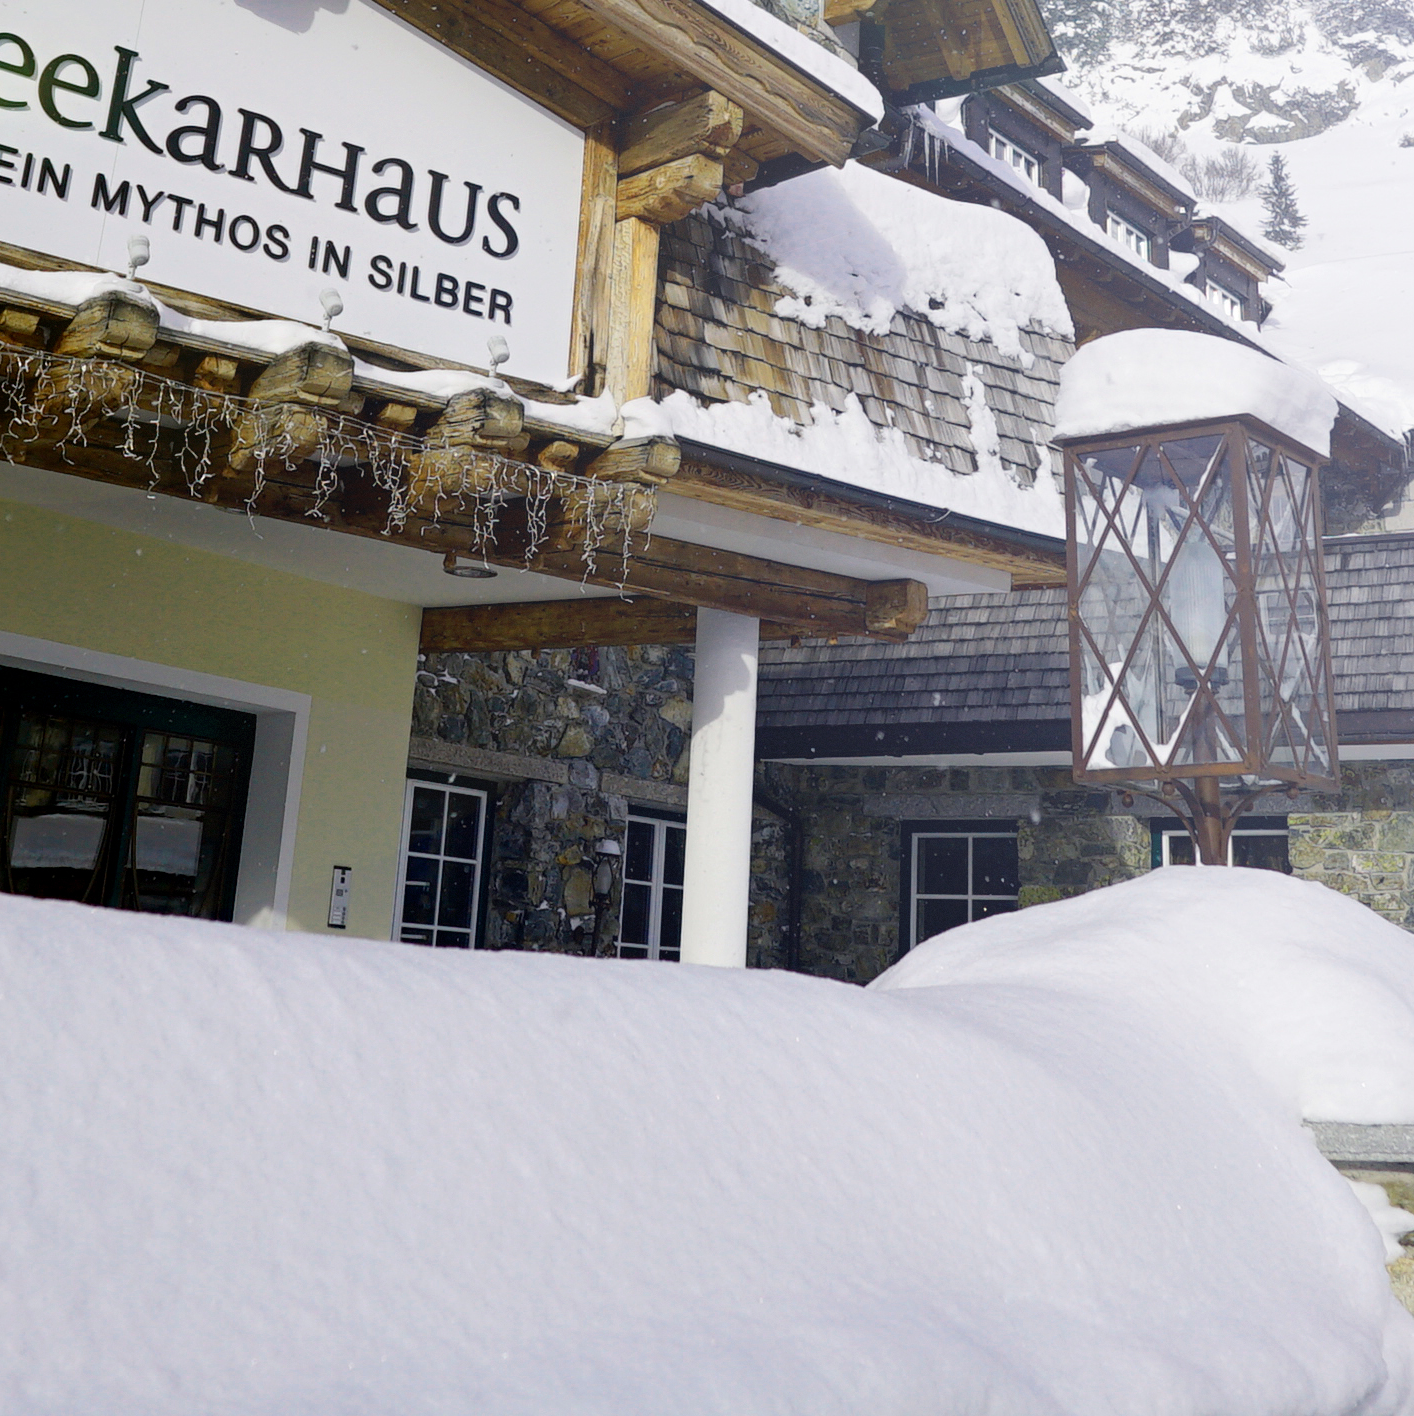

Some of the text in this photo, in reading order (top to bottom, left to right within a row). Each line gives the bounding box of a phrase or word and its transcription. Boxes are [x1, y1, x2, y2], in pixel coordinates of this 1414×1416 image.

[90, 172, 292, 262] MYTHOS
[307, 235, 353, 282] IN
[367, 253, 516, 327] SILBER
